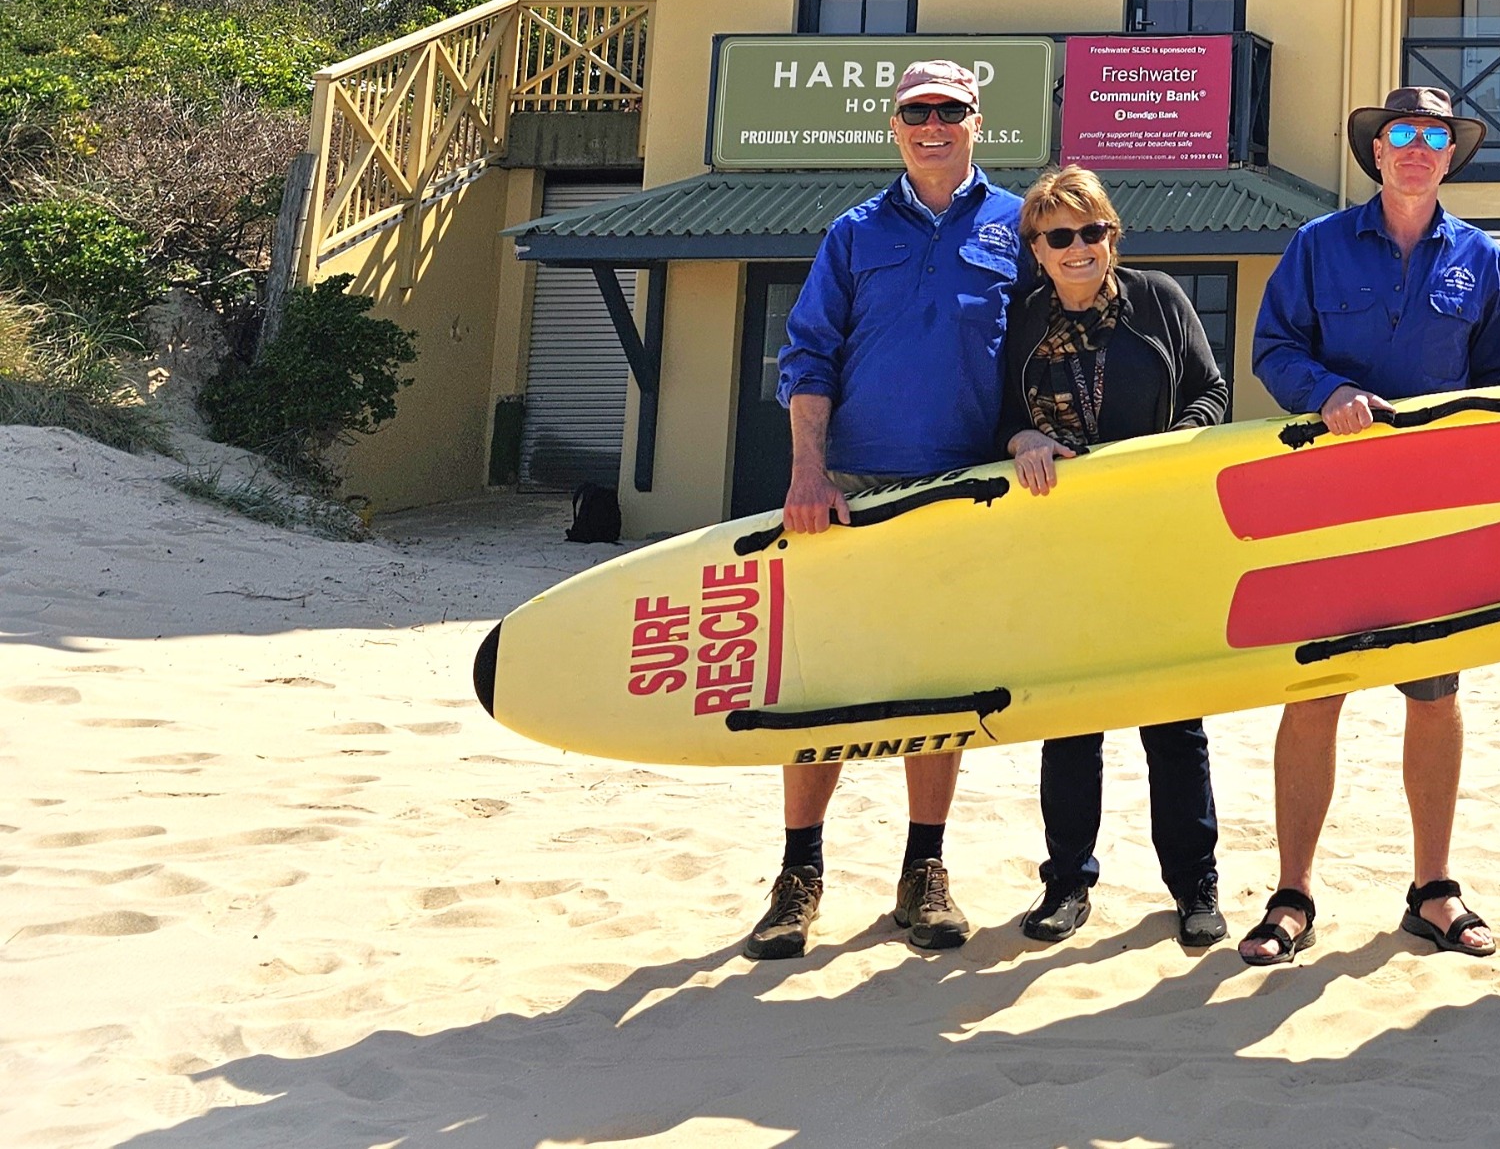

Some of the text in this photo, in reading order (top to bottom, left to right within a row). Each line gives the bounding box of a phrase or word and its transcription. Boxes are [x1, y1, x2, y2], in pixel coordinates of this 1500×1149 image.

[1090, 46, 1206, 55] Freshwater SLSC is sponsored by
[774, 61, 994, 88] HARBD
[1102, 66, 1197, 82] Freshwater
[1090, 90, 1162, 104] Community
[846, 98, 890, 113] HOT
[1127, 111, 1157, 119] Bendigo
[741, 130, 799, 144] PROUDLY
[803, 129, 883, 144] SPONSORING
[1079, 131, 1105, 139] proudly
[1106, 131, 1143, 139] supporting
[1190, 131, 1212, 139] saving
[1106, 141, 1133, 149] keeping
[627, 596, 690, 695] SURF
[694, 560, 760, 716] RESCUE
[792, 730, 976, 764] BENNETT
